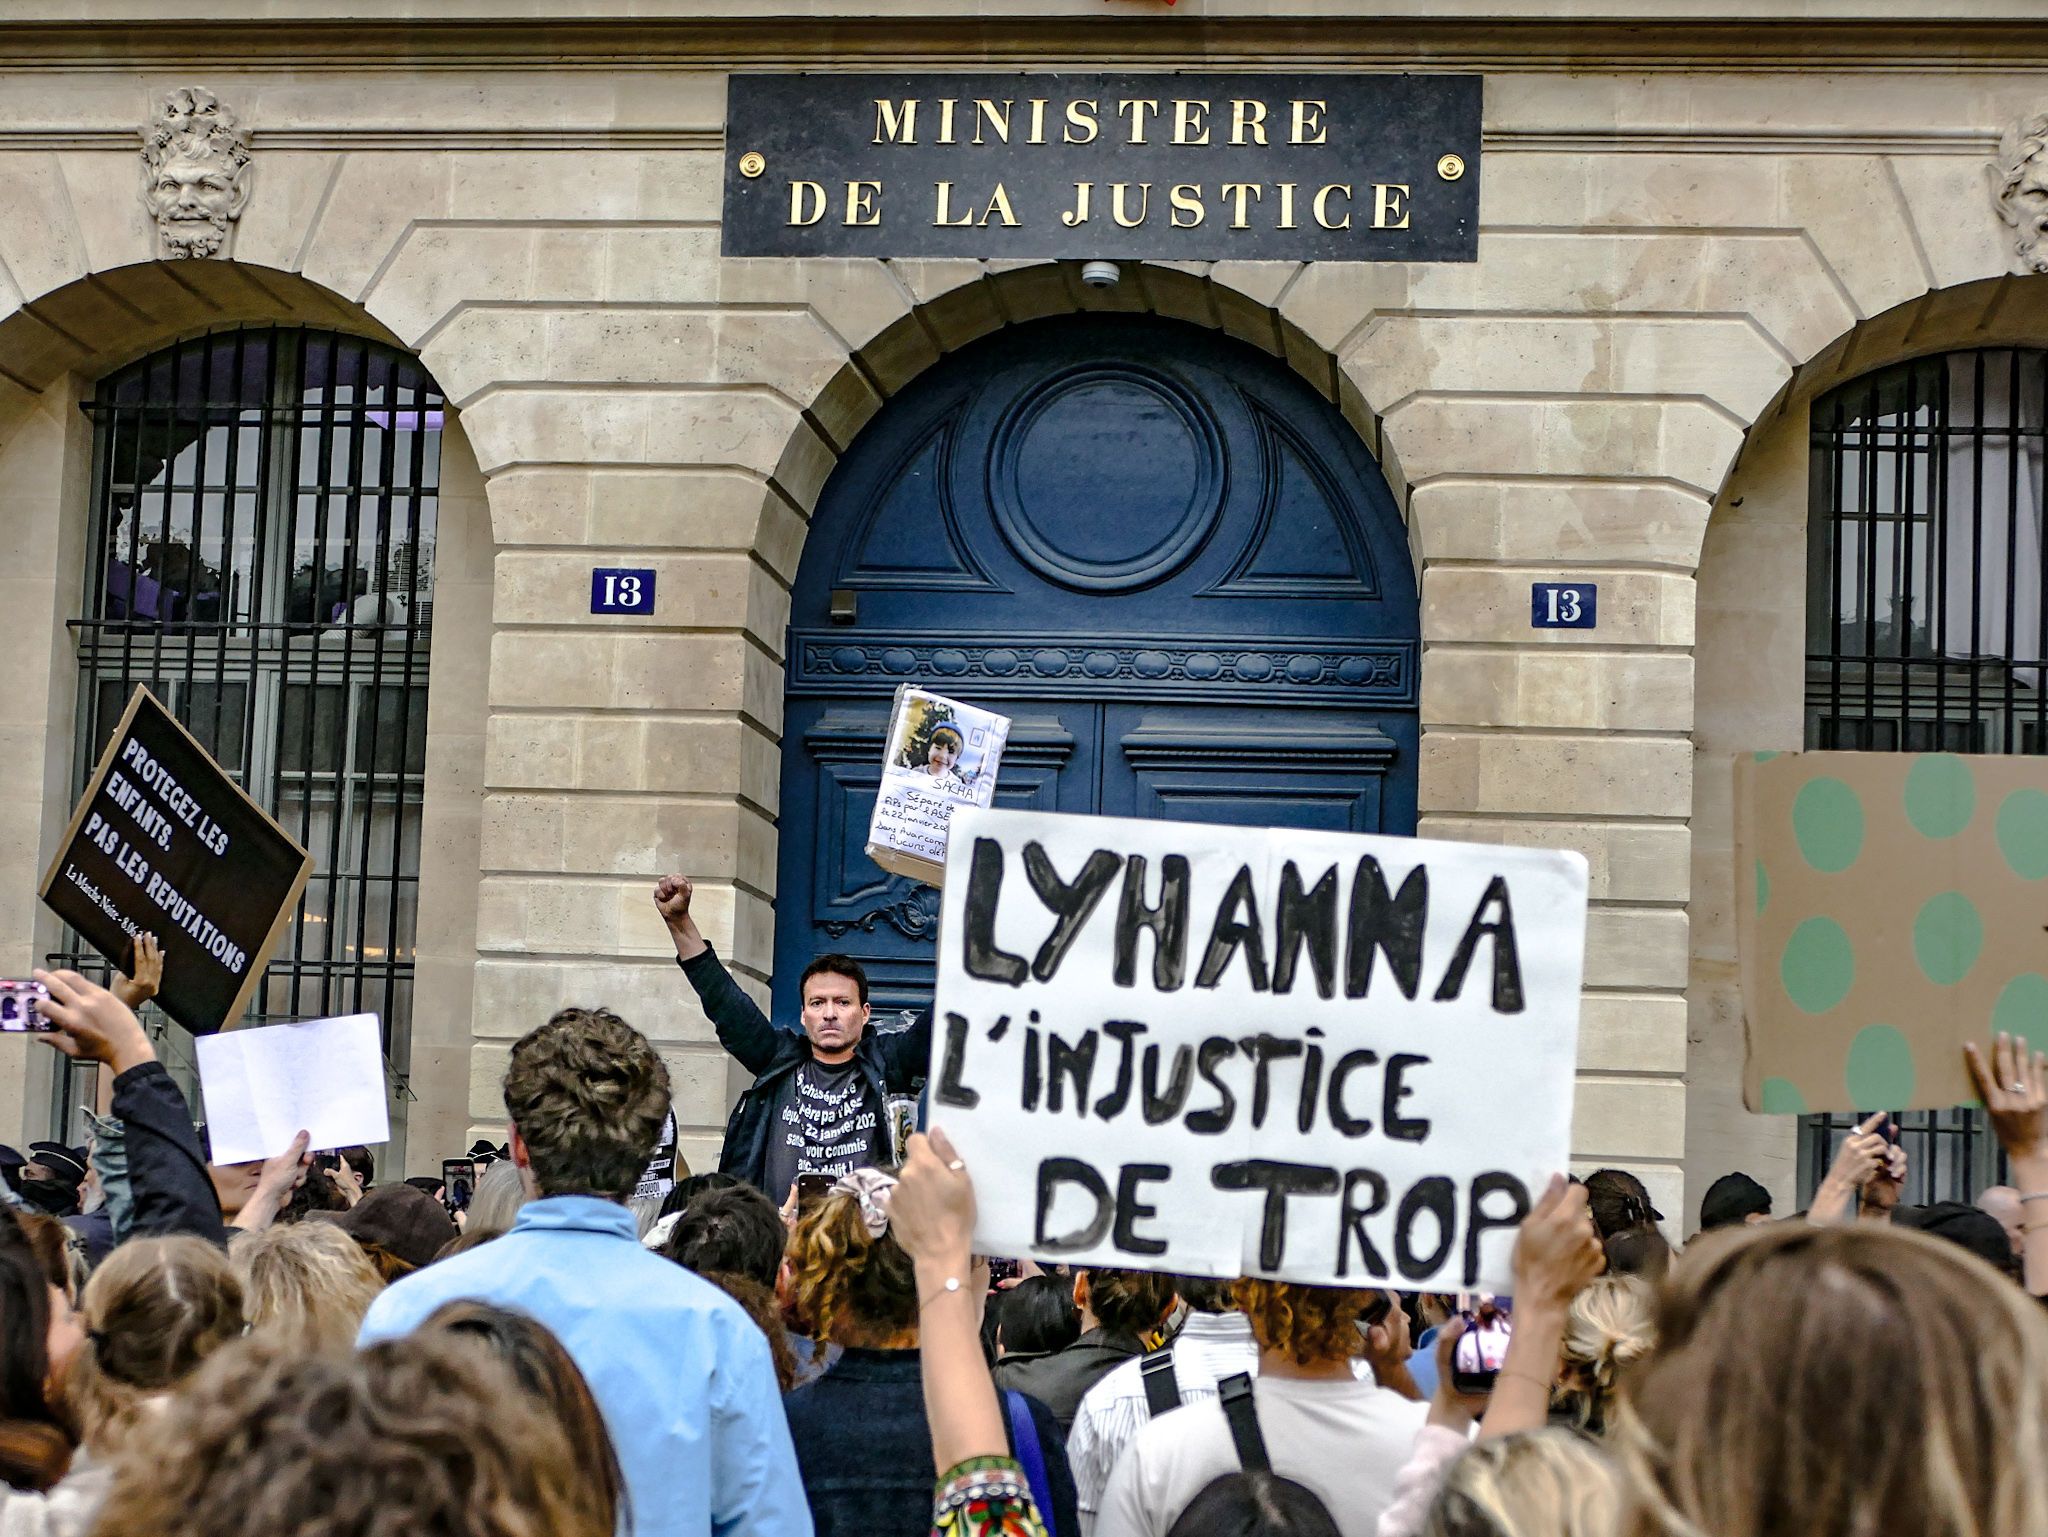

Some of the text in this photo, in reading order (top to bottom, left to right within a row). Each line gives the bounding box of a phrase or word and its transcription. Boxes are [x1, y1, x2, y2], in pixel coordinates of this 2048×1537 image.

[871, 97, 1329, 146] MINISTERE
[785, 180, 1413, 231] DE LA JUSTICE
[602, 575, 642, 607] 13
[1545, 588, 1582, 623] 13
[121, 736, 230, 857] PROTEGEZ LES
[932, 778, 974, 799] SACHA
[83, 811, 246, 975] PAS LES REPUTATIONS
[796, 1073, 820, 1100] Scha
[804, 1121, 819, 1139] 22
[824, 1137, 868, 1159] commis
[1030, 1157, 1532, 1287] DE TROP
